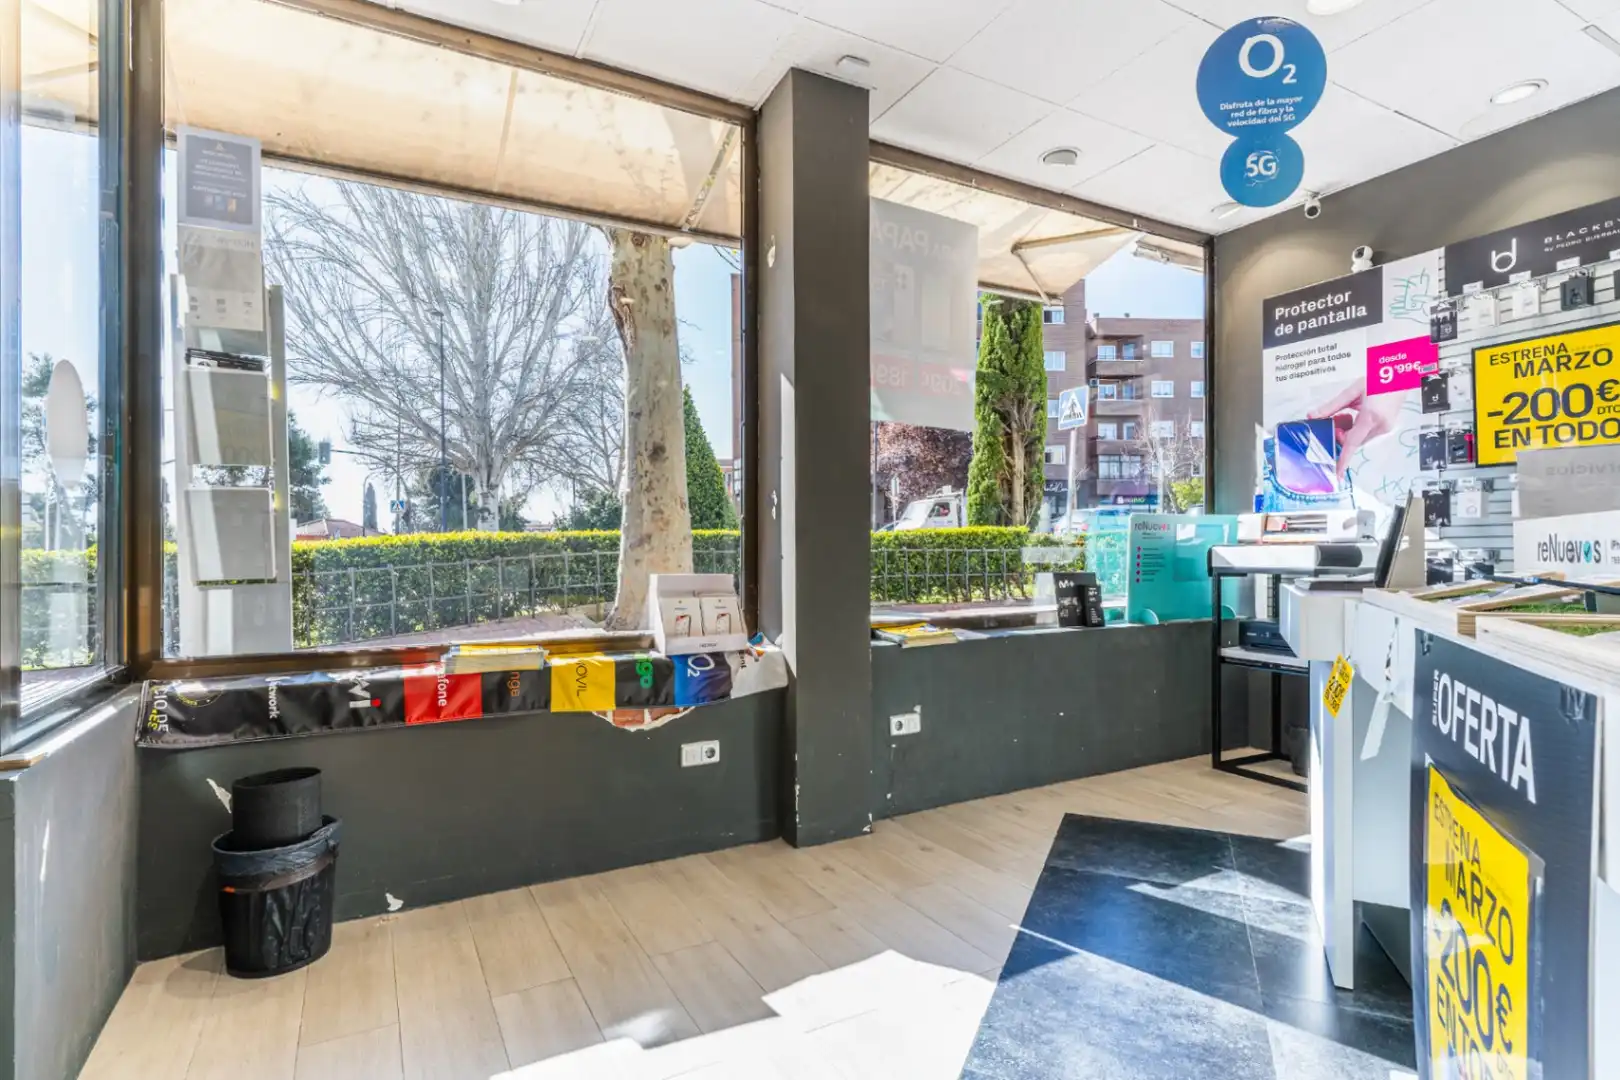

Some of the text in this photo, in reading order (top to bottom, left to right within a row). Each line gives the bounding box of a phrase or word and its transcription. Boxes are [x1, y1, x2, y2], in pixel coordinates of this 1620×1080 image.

[1238, 33, 1298, 85] O2
[1219, 96, 1303, 111] Disfruta de la mayor
[1230, 110, 1245, 118] red
[1246, 109, 1257, 117] de
[1258, 107, 1278, 115] fibra
[1227, 117, 1267, 127] velocidad
[1268, 115, 1281, 124] del
[1245, 152, 1277, 178] 5G
[1275, 291, 1352, 320] Protector
[1274, 305, 1367, 337] de pantalla
[1275, 343, 1338, 362] Protección total
[1275, 351, 1352, 372] hidrogel para todos
[1379, 352, 1407, 364] desde
[1489, 342, 1569, 366] ESTRENA
[1513, 348, 1614, 379] MARZO
[1275, 365, 1337, 382] tus dispositivos
[1494, 427, 1531, 449] EN
[437, 673, 450, 707] afone
[507, 671, 521, 697] nge
[576, 660, 588, 697] OVIL
[1438, 672, 1537, 805] OFERTA
[1445, 838, 1515, 966] MARZO
